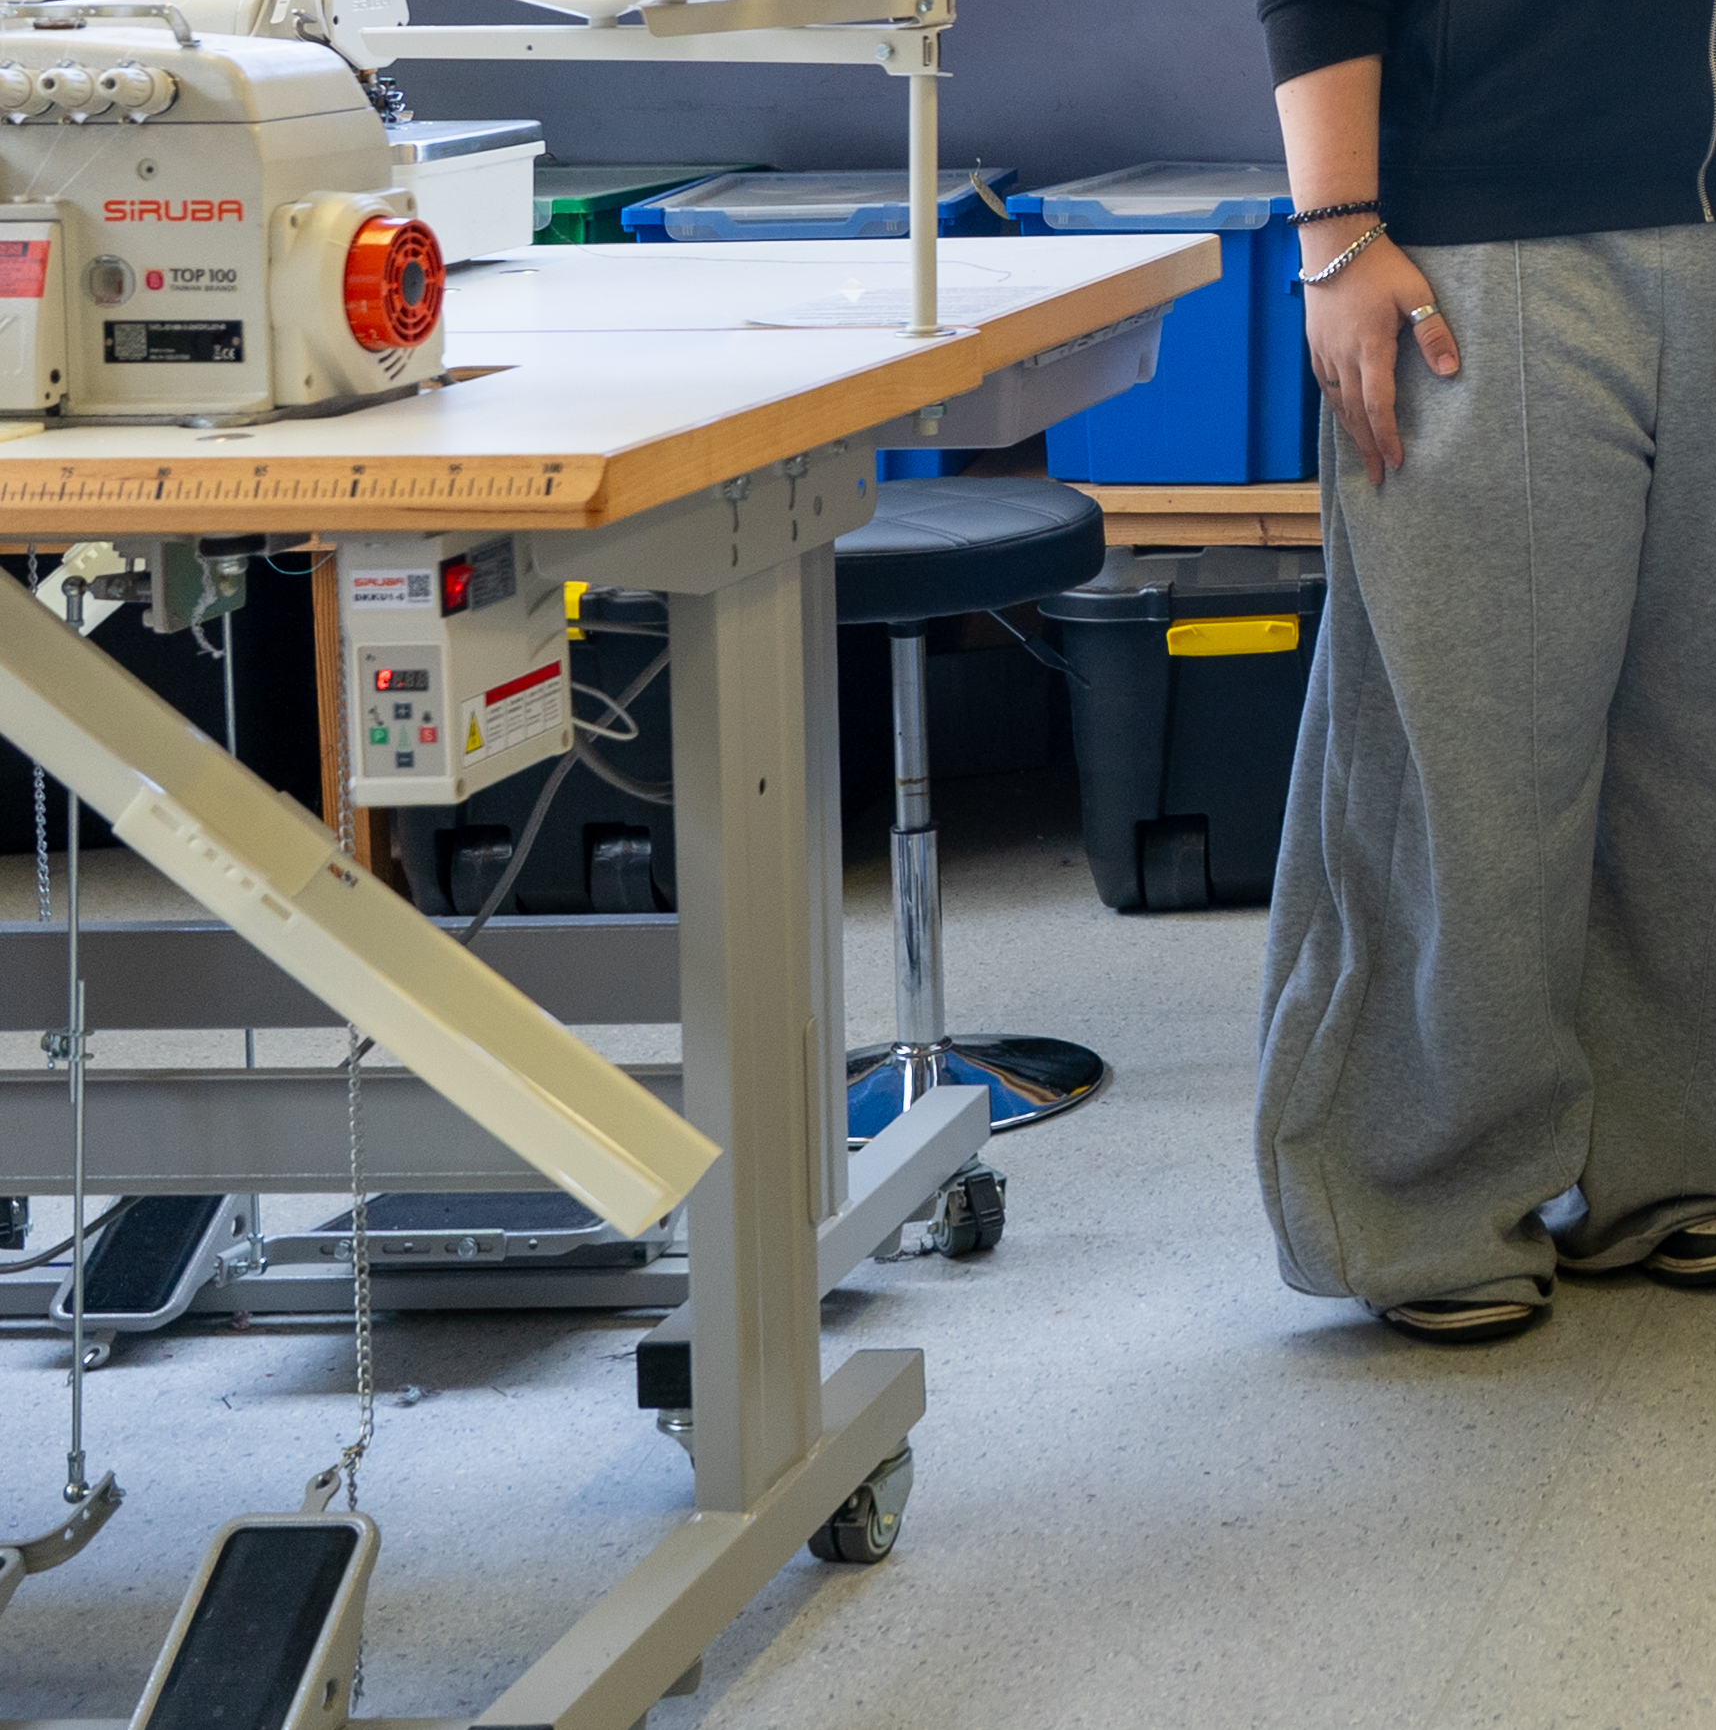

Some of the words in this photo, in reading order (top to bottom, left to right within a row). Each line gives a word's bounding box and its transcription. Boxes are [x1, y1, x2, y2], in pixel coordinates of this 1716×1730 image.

[169, 268, 204, 283] TOP
[209, 268, 238, 283] 100
[61, 466, 75, 479] 75
[157, 466, 172, 478] 80
[352, 464, 366, 475] 90
[449, 463, 463, 474] 95
[542, 462, 563, 474] 100
